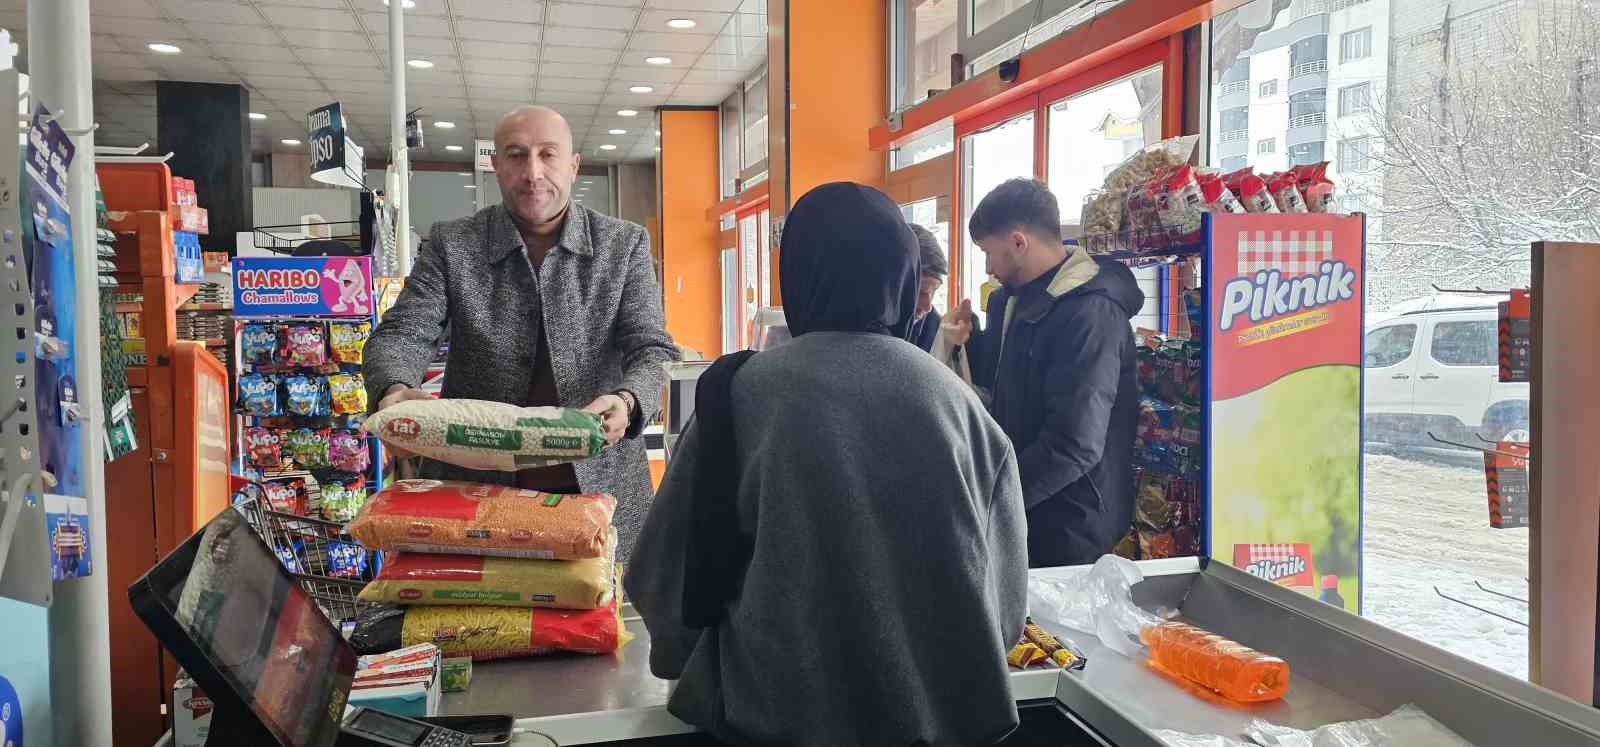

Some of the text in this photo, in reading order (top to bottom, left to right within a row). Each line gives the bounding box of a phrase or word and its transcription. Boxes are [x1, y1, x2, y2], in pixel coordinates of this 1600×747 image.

[238, 269, 320, 289] HARIBO
[241, 290, 319, 304] Chamallows
[1220, 262, 1354, 330] Piknik
